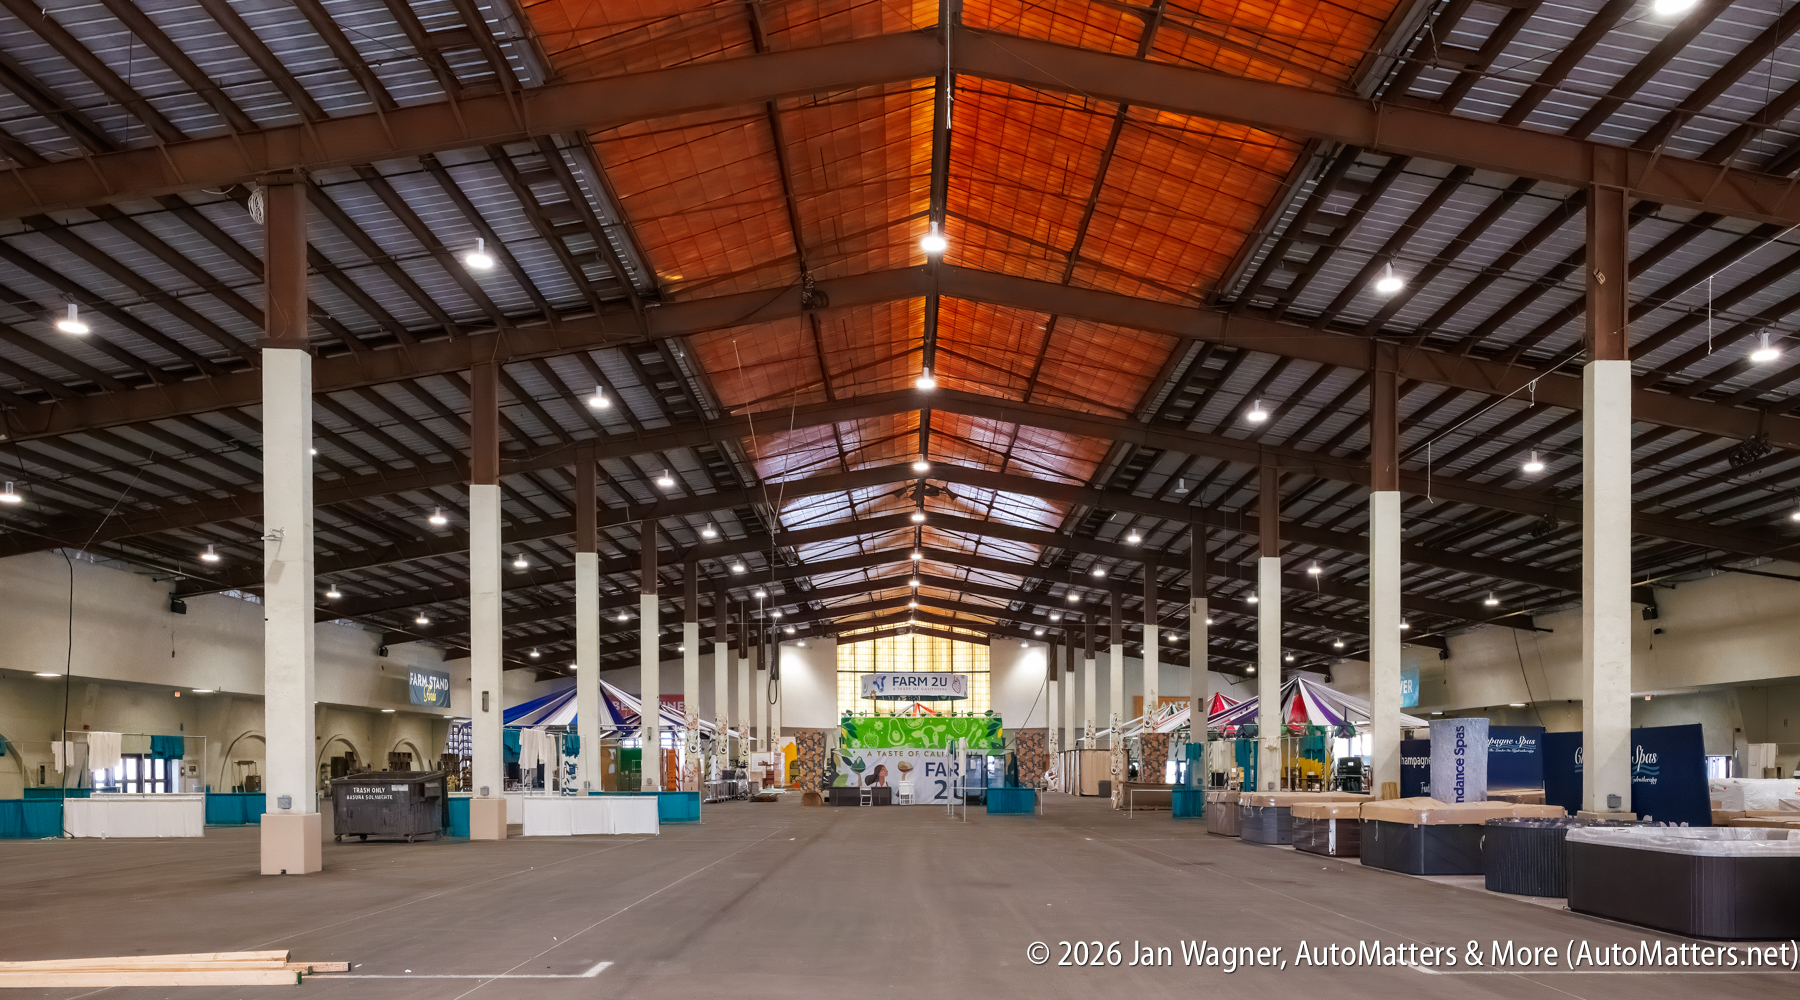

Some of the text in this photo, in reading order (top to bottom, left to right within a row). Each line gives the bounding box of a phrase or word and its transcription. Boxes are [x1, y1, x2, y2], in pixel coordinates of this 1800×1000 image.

[409, 672, 449, 690] FARM STAND
[892, 676, 948, 687] FARM 2U
[1487, 735, 1536, 748] pagne Spas
[1400, 754, 1431, 769] hampagne
[1453, 725, 1468, 803] ndance Spas
[1631, 744, 1658, 772] Spas
[925, 761, 960, 777] FAR
